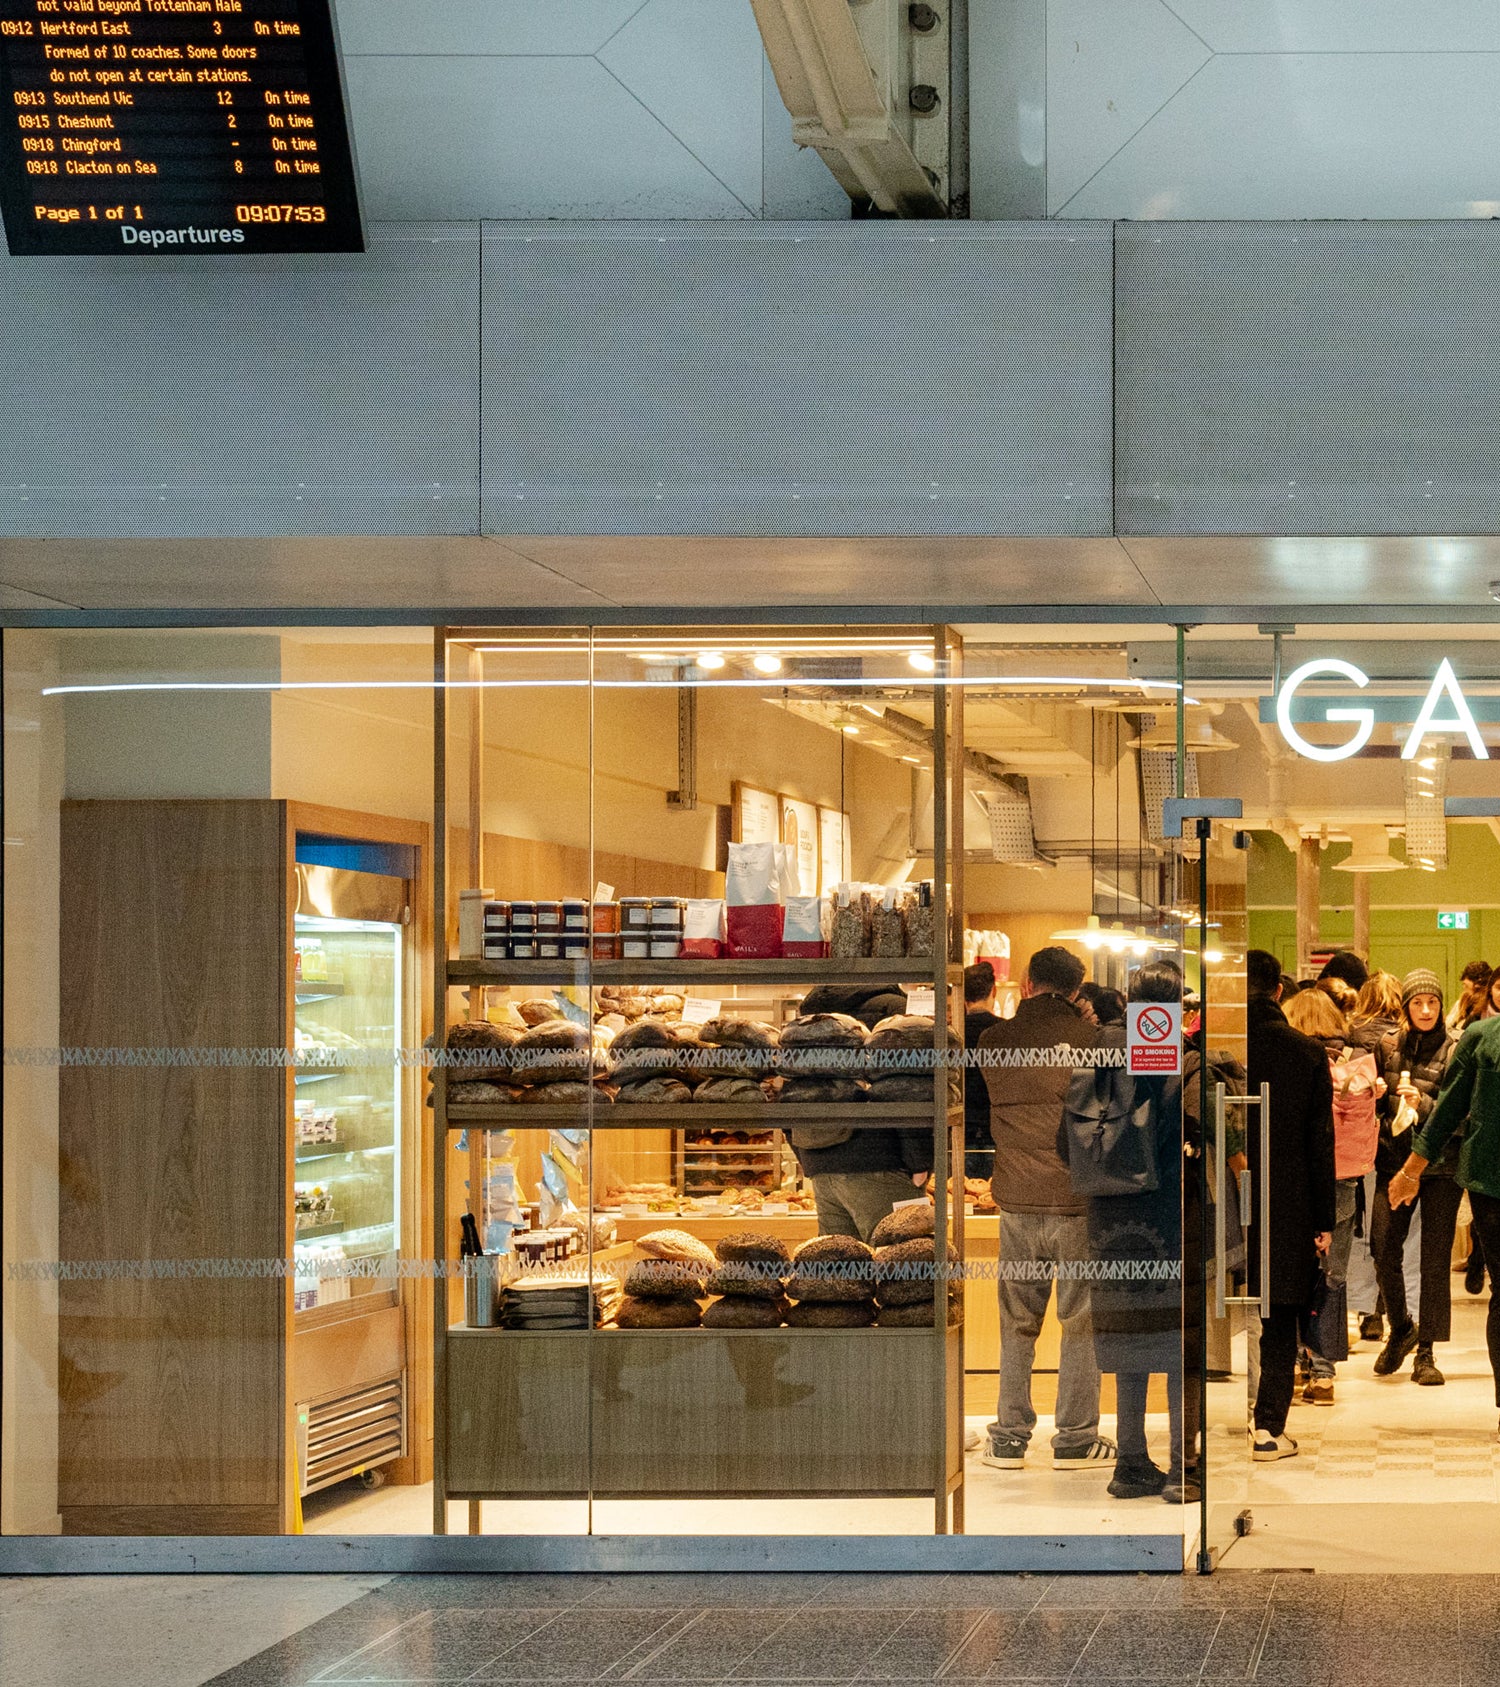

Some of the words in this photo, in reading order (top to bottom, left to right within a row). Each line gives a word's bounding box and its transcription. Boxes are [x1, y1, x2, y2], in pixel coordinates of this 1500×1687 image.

[37, 0, 59, 11] not
[64, 0, 94, 11] valid
[98, 0, 141, 14] beyond
[145, 0, 211, 11] Tottenham
[215, 0, 242, 11] Hale
[1, 21, 33, 35] 09:12
[41, 21, 98, 35] Hertford
[101, 21, 131, 35] East
[213, 21, 222, 34] 3
[254, 21, 270, 34] On
[274, 21, 300, 34] time
[45, 45, 90, 58] Formed
[94, 45, 107, 58] of
[113, 45, 126, 58] 10
[131, 45, 183, 58] coaches.
[187, 45, 217, 58] Some
[222, 45, 256, 58] doors
[50, 69, 65, 82] do
[69, 69, 91, 82] not
[95, 72, 124, 85] open
[129, 69, 143, 82] at
[147, 68, 192, 82] certain
[197, 68, 251, 82] stations.
[14, 91, 46, 105] 09:13
[53, 91, 110, 105] Southend
[113, 91, 133, 104] Vic
[217, 91, 232, 104] 12
[265, 91, 280, 104] On
[284, 91, 310, 104] time
[19, 115, 50, 128] 09:15
[58, 115, 114, 128] Cheshunt
[228, 115, 236, 128] 2
[268, 114, 284, 127] On
[288, 114, 313, 127] time
[23, 138, 54, 151] 09:18
[62, 138, 121, 154] Chingford
[272, 137, 287, 150] On
[291, 137, 317, 150] time
[27, 160, 58, 174] 09:18
[66, 160, 112, 174] Clacton
[116, 163, 131, 173] on
[135, 160, 157, 173] Sea
[235, 160, 243, 173] 8
[275, 160, 290, 173] On
[294, 160, 320, 173] time
[35, 206, 80, 222] Page
[89, 206, 97, 219] 1
[105, 206, 124, 219] of
[134, 206, 143, 219] 1
[236, 205, 325, 222] 09:07:53
[121, 226, 245, 247] Departures
